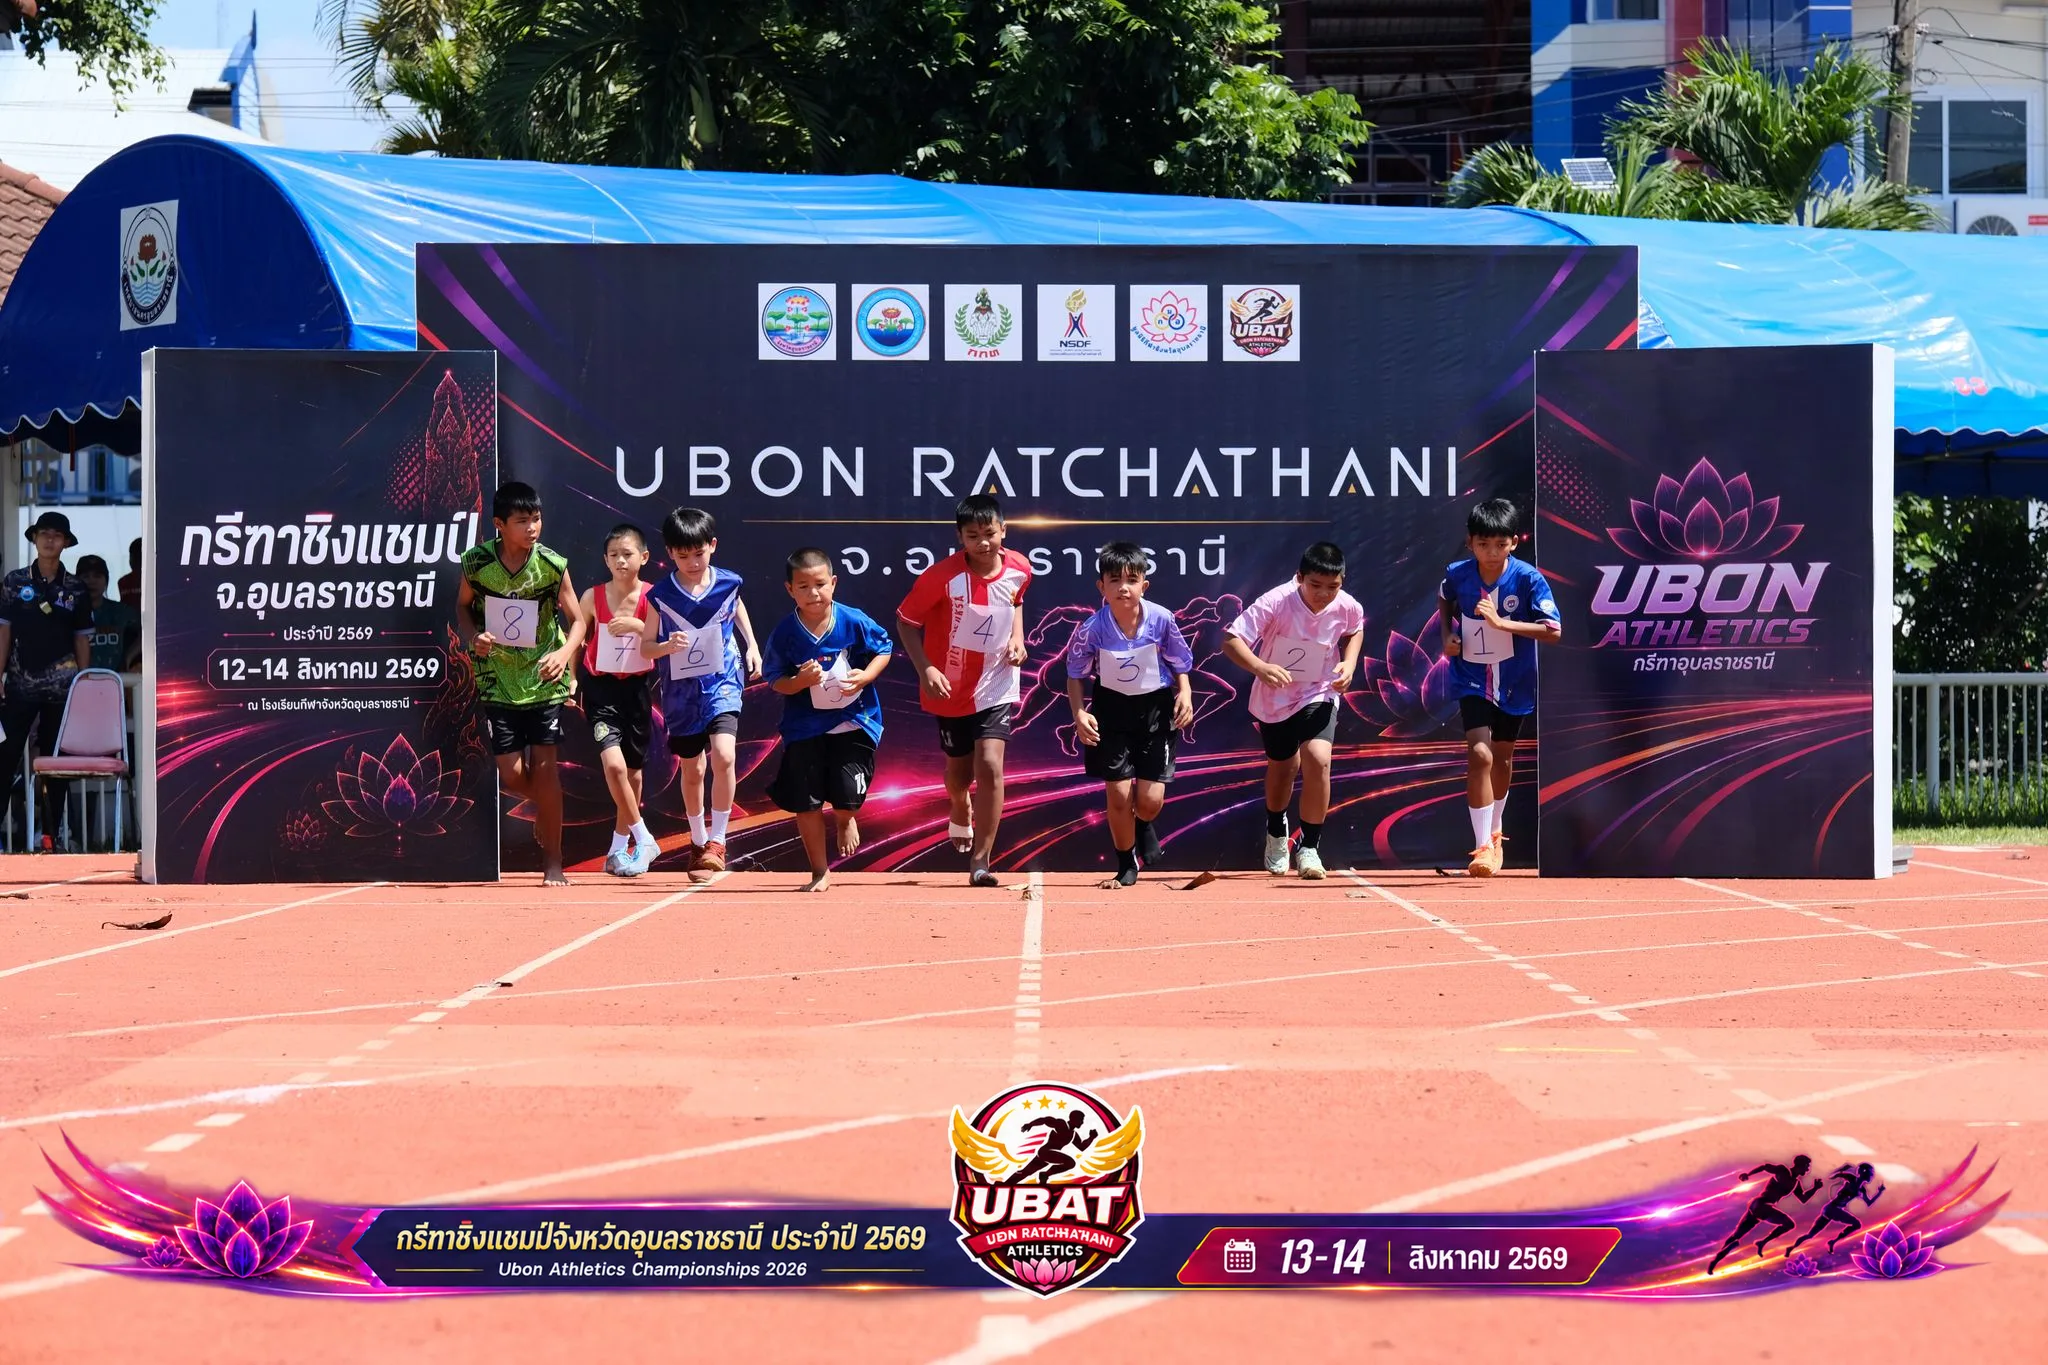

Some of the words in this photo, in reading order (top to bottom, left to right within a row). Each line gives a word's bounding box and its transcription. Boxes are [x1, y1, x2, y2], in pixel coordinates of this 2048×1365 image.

[1059, 340, 1091, 348] NSDF
[1235, 323, 1289, 338] UBAT
[616, 446, 864, 497] UBON
[913, 446, 1457, 497] RATCHATHANI
[216, 570, 436, 620] จ.อุบลราชธานี
[1591, 562, 1832, 615] UBON
[283, 625, 333, 641] ประจำปี
[337, 626, 373, 641] 2569
[503, 605, 524, 641] 8
[972, 613, 994, 645] 4
[1591, 618, 1821, 649] ATHLETICS
[614, 635, 636, 663] 7
[687, 636, 704, 665] 6
[1473, 625, 1495, 655] 1
[297, 657, 378, 680] สิงหาคม
[385, 657, 440, 679] 2569
[1116, 655, 1140, 683] 3
[1284, 647, 1306, 673] 2
[247, 701, 258, 711] ณ
